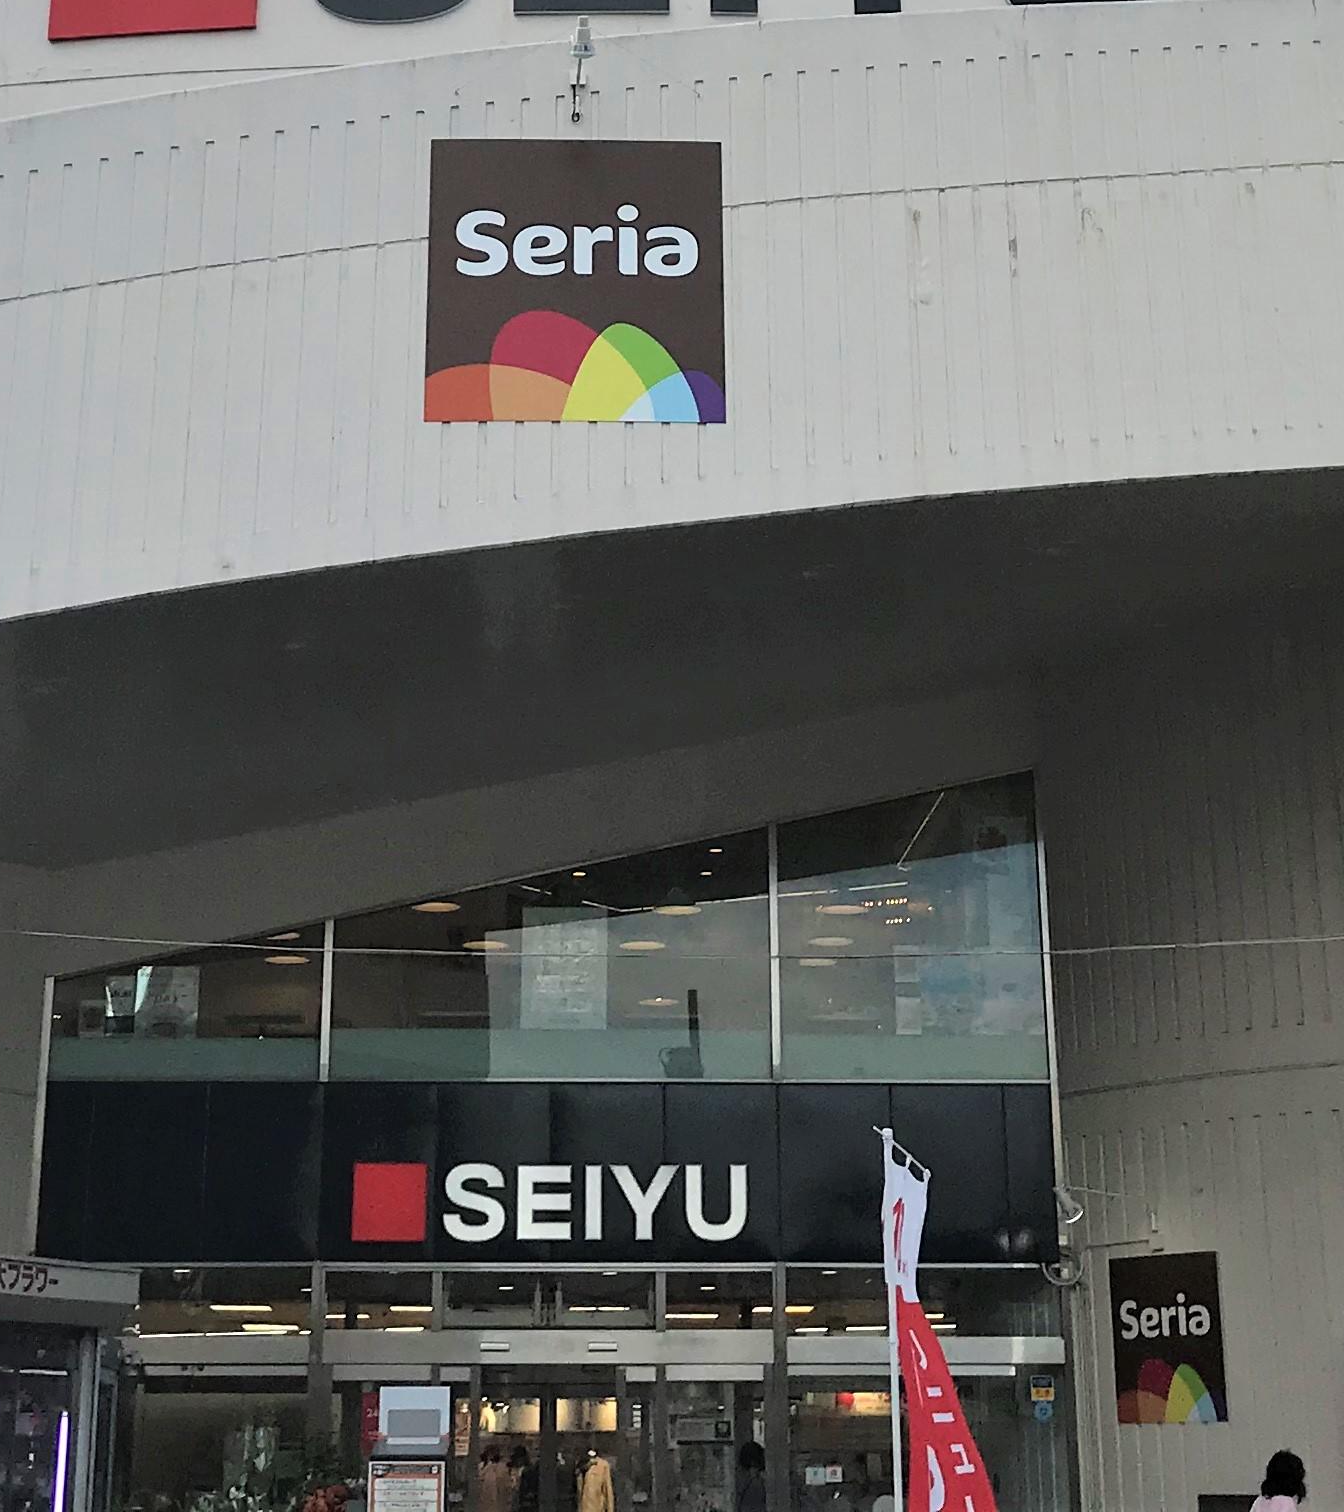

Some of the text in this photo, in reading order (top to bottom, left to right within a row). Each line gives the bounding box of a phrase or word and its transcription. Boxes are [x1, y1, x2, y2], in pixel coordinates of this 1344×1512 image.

[455, 205, 699, 277] Seria
[443, 1163, 748, 1242] SEIYU
[1120, 1293, 1211, 1341] Seria
